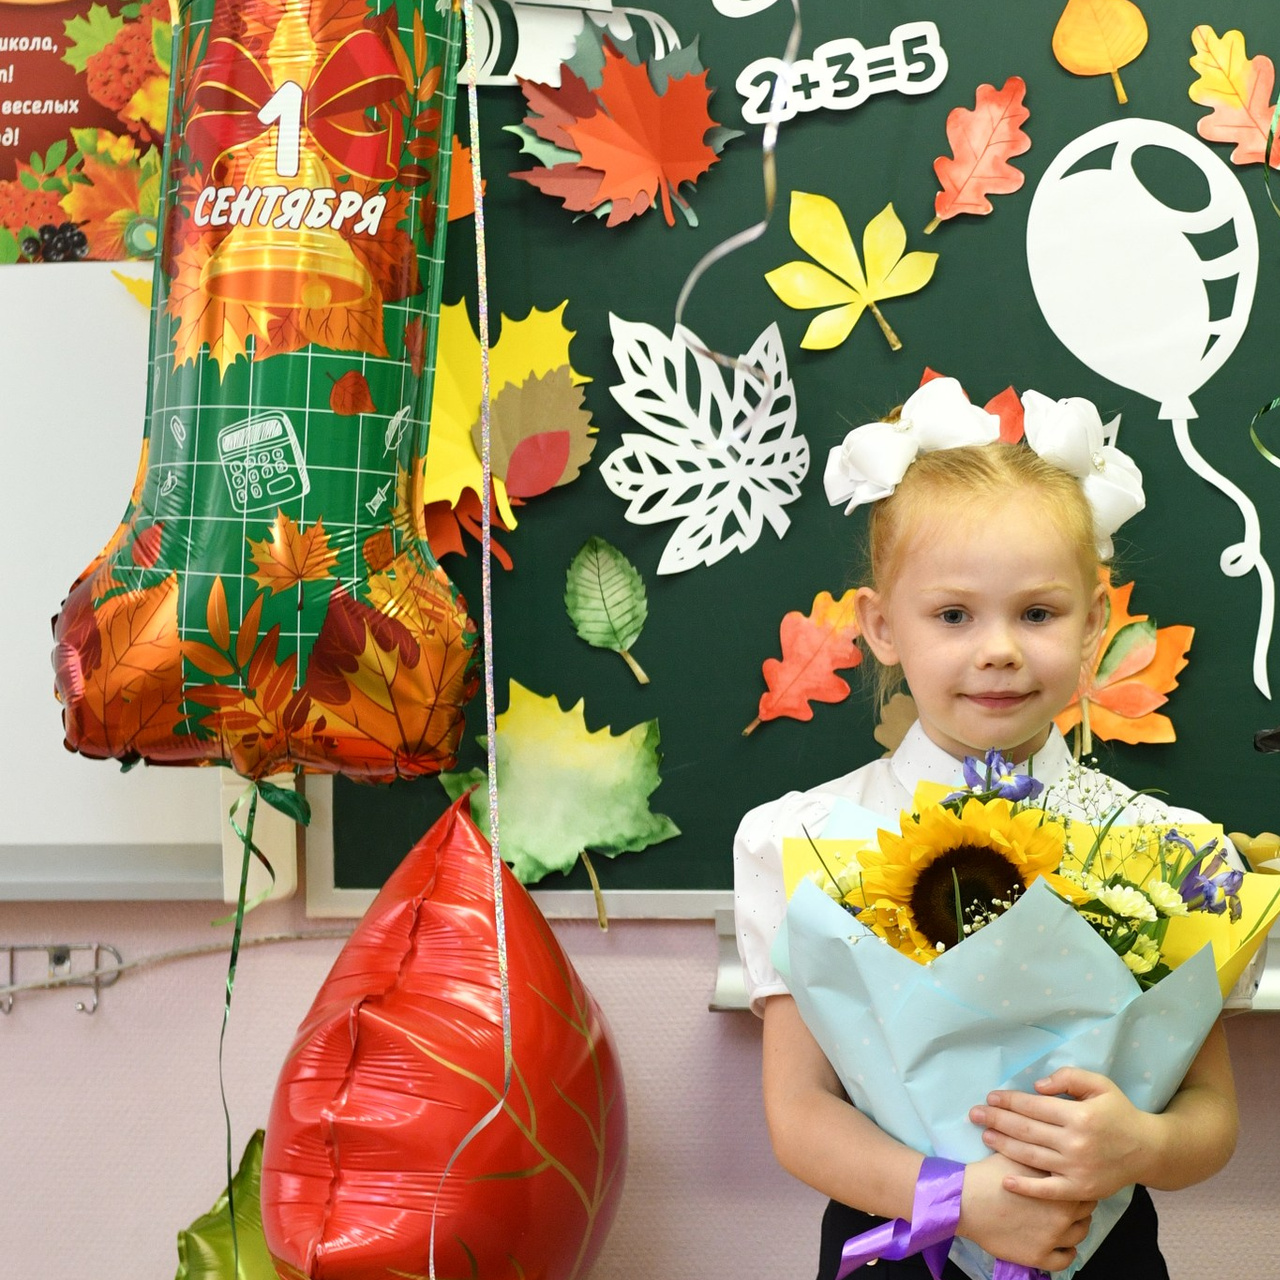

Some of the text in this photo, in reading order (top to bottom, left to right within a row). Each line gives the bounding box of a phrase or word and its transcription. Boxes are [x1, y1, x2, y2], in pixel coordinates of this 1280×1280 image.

[2, 99, 79, 115] веселых
[744, 29, 941, 118] 2+3=5
[258, 80, 305, 177] 1
[194, 186, 387, 236] СЕНТЯБРЯ
